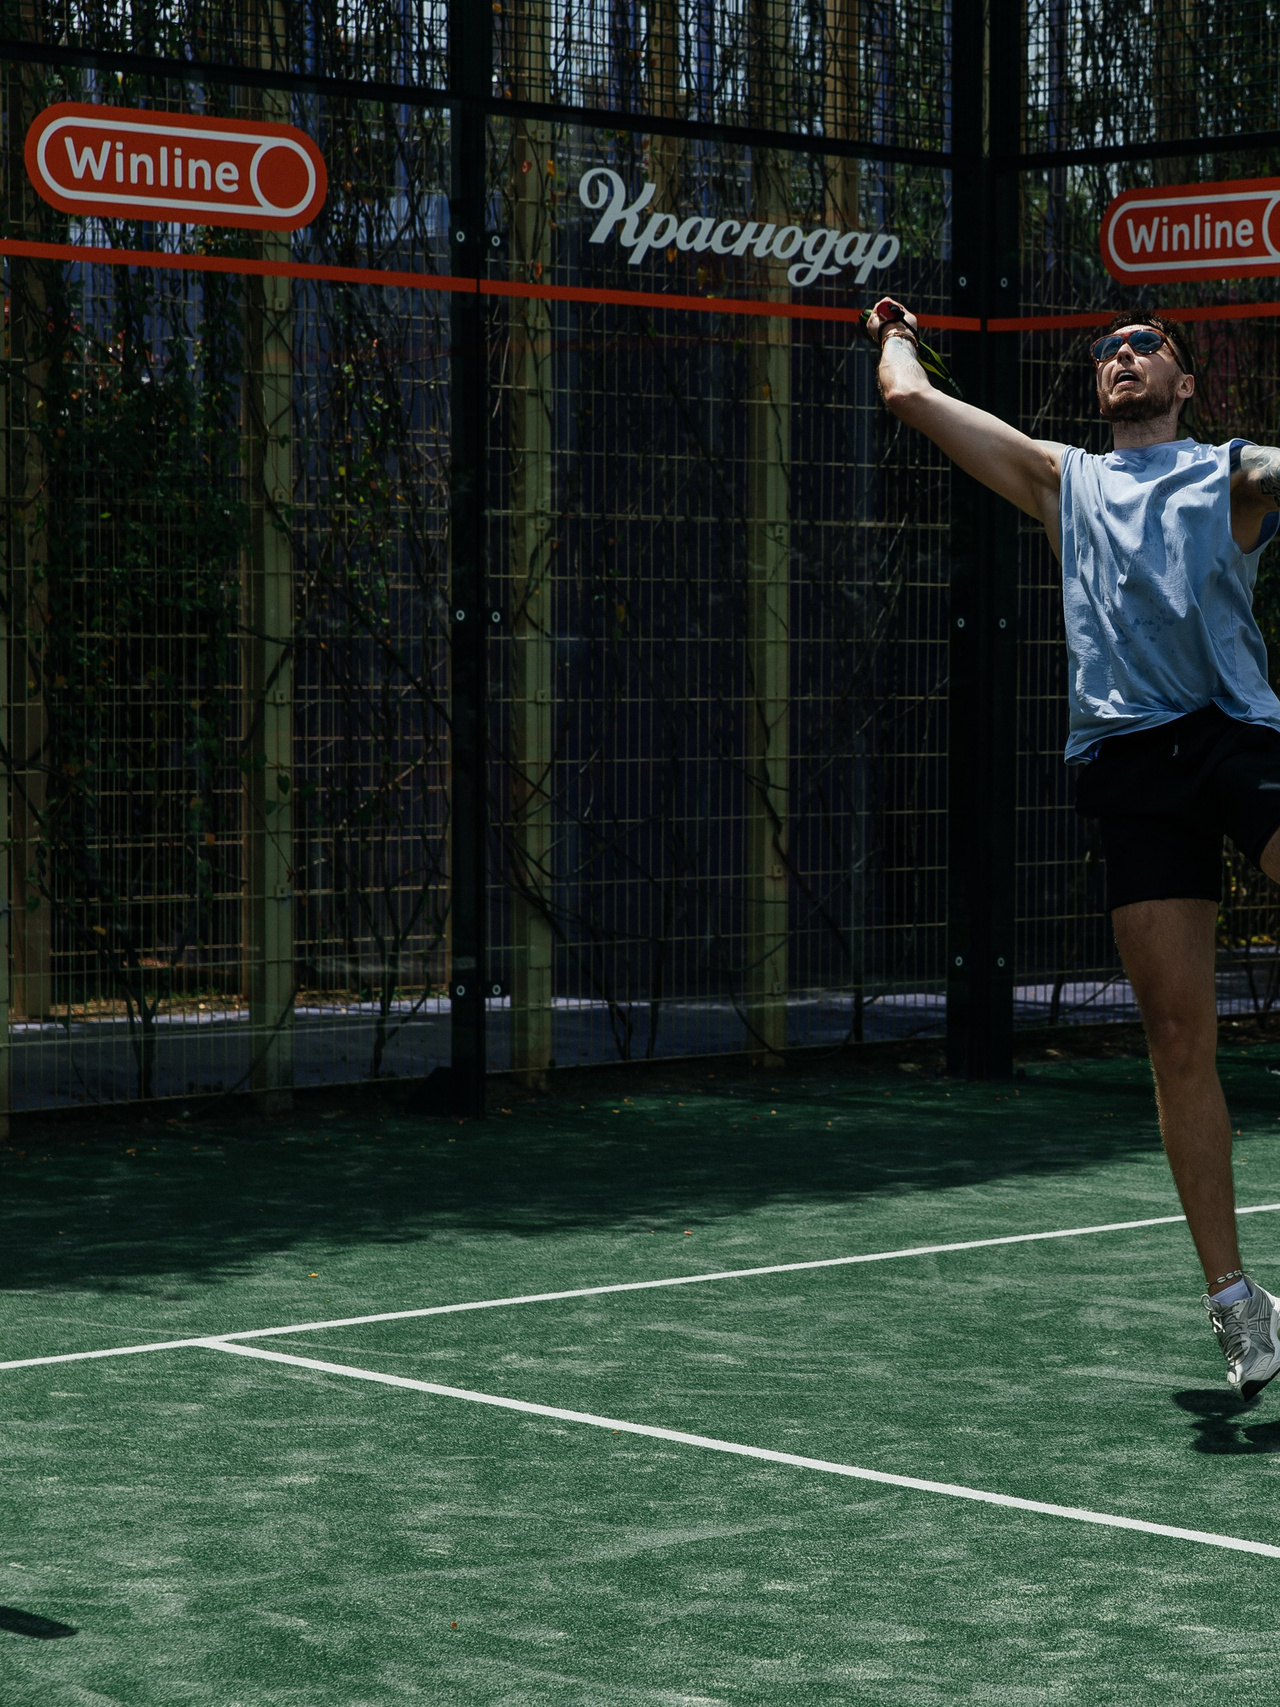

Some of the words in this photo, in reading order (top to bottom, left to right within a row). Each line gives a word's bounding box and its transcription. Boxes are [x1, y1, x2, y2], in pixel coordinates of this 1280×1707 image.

[64, 138, 240, 192] Winline
[580, 168, 899, 286] Краснодар
[1126, 214, 1254, 254] Winline
